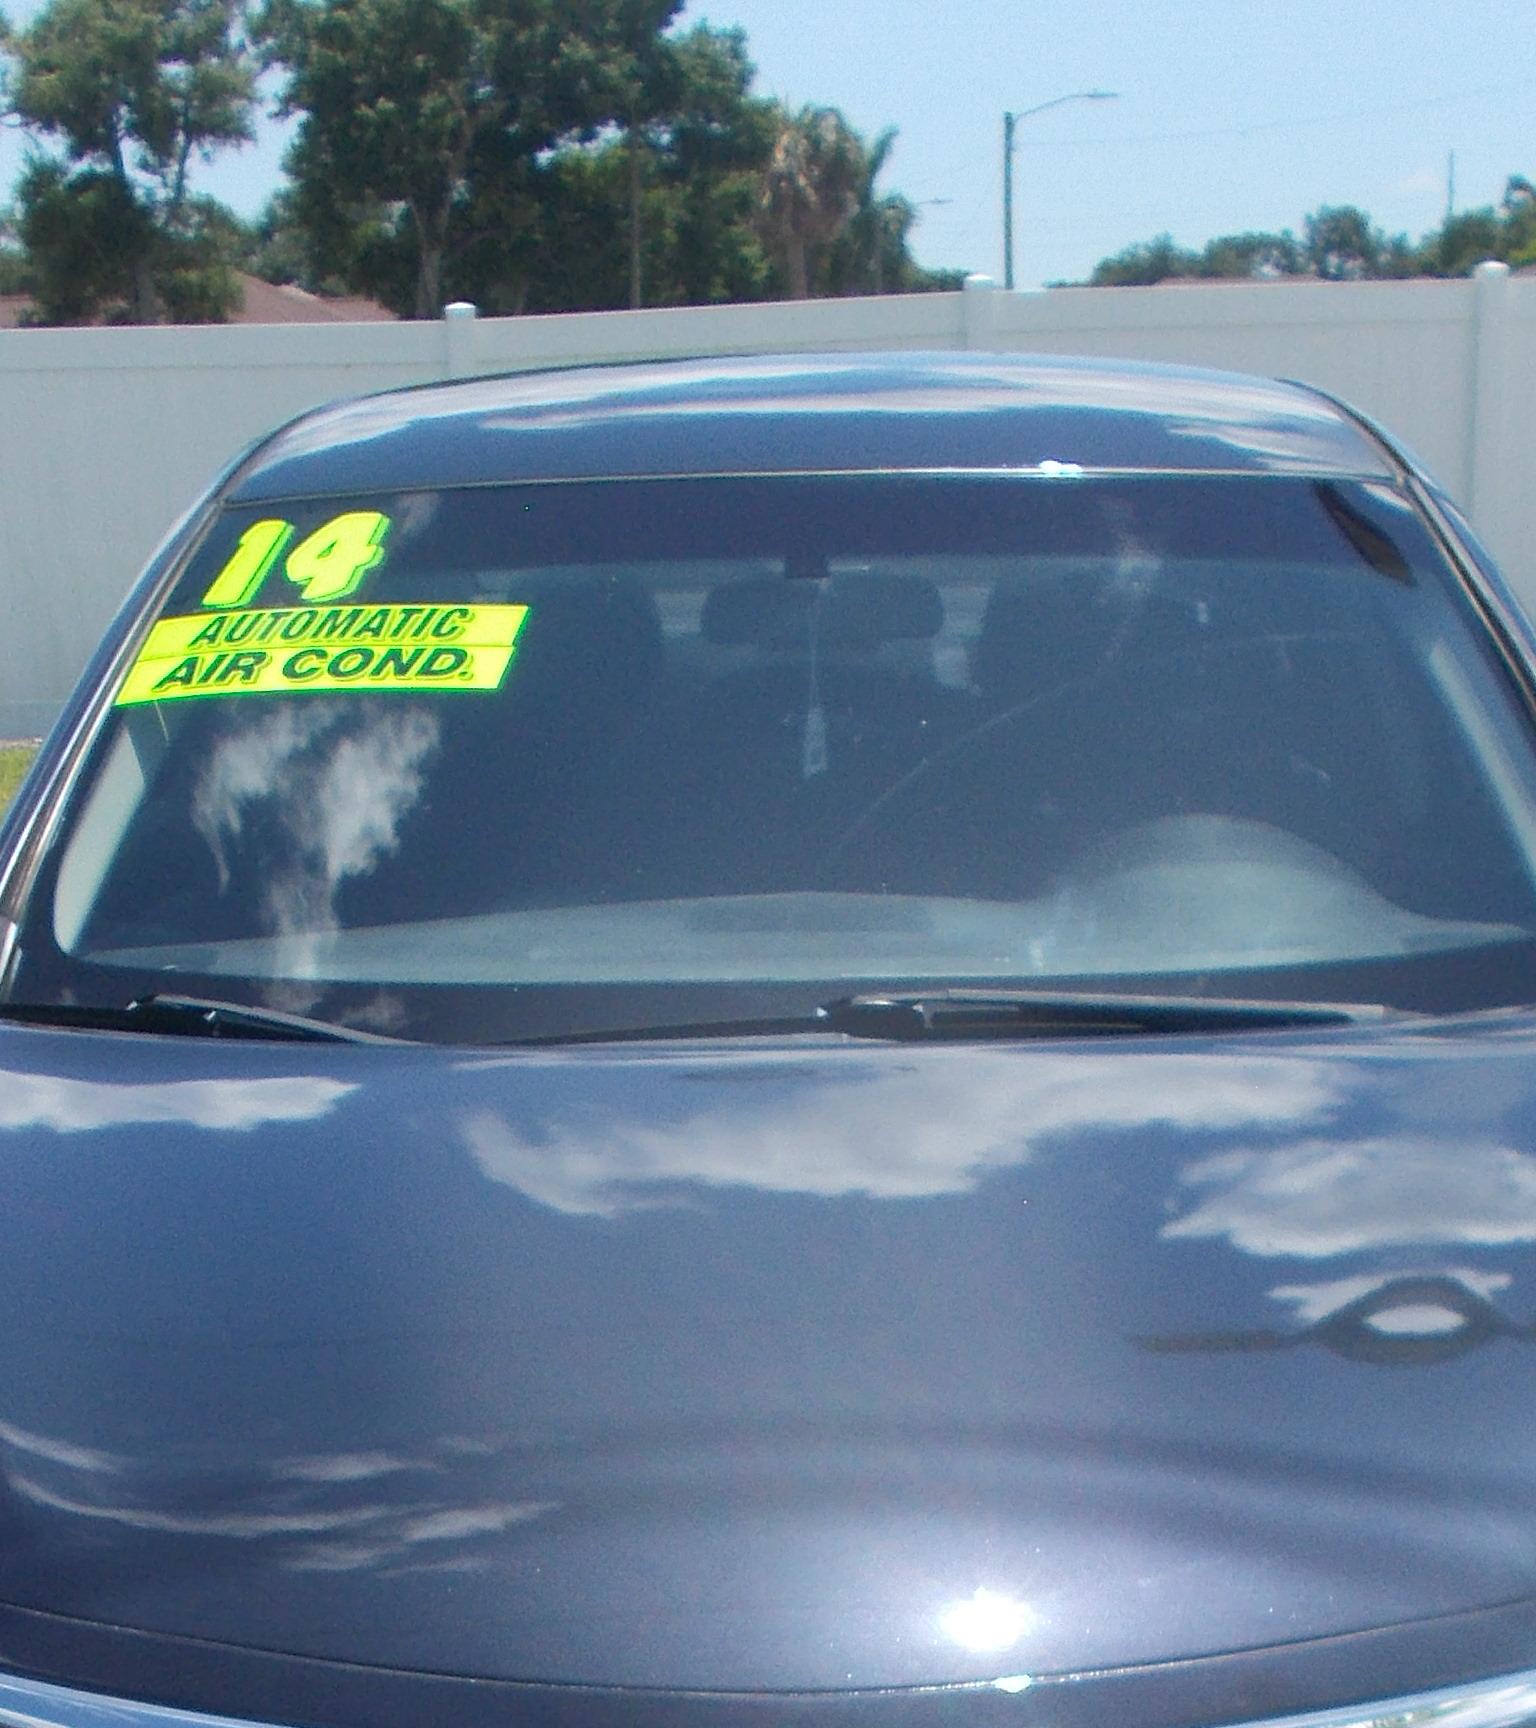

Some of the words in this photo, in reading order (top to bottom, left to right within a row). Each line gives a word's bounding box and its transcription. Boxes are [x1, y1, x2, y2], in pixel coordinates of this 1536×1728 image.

[201, 511, 390, 608] 14
[188, 607, 476, 648] AUTOMATIC
[151, 650, 272, 692] AIR
[281, 647, 473, 683] COND.
